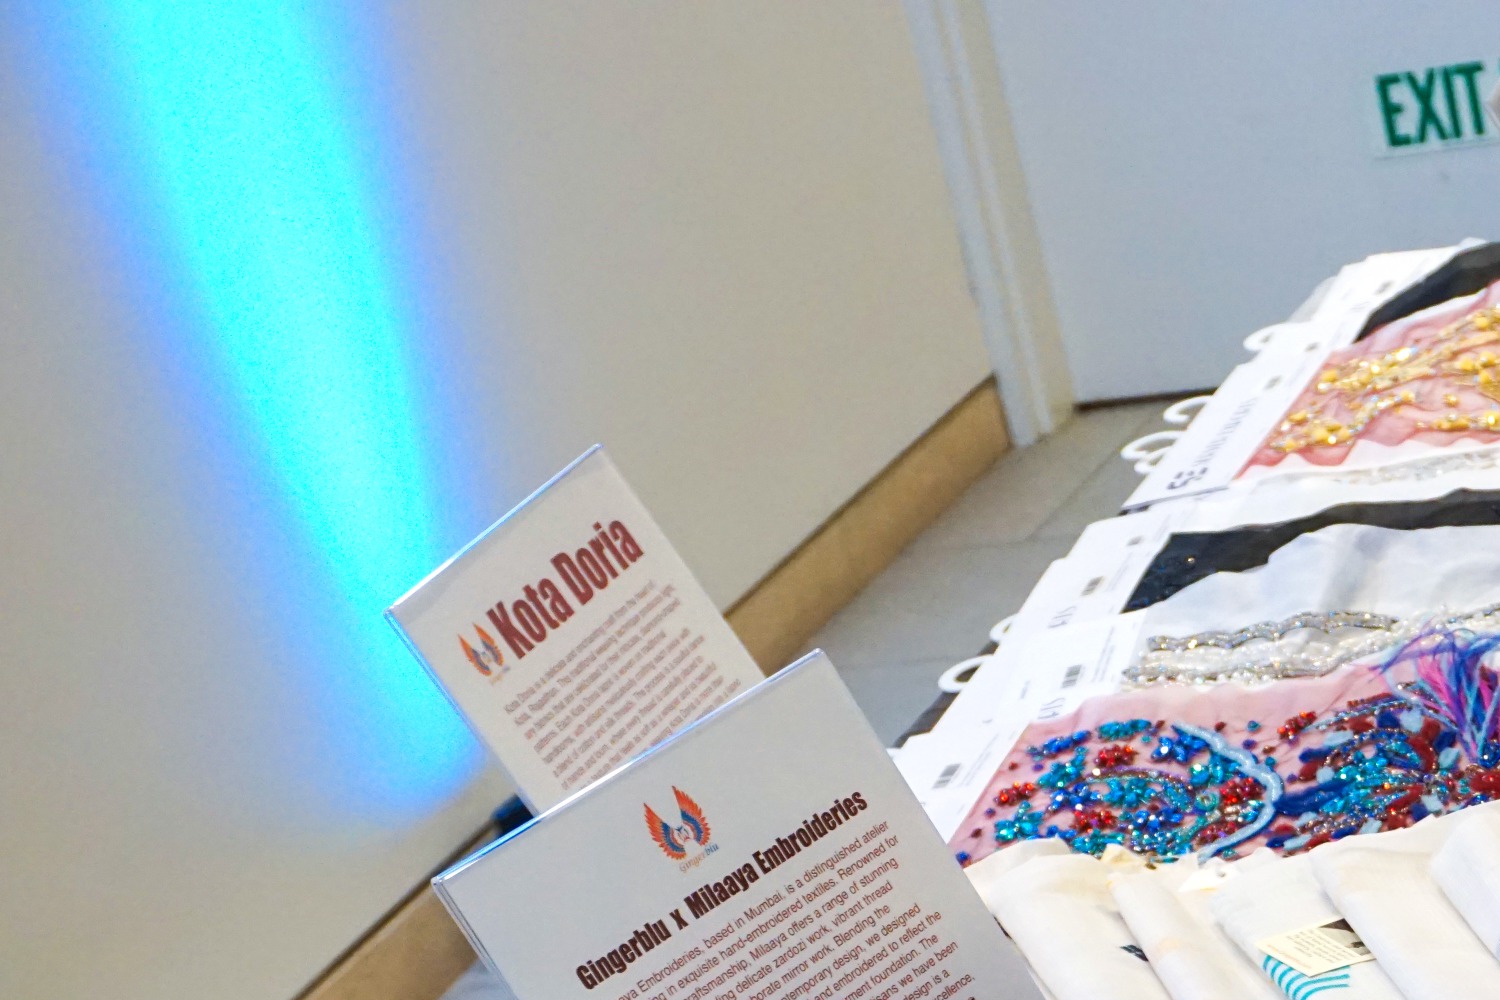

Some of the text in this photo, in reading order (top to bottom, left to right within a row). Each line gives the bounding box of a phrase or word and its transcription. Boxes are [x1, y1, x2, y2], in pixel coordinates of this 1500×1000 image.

[1375, 61, 1485, 147] EXIT
[486, 520, 645, 660] Kota Doria
[576, 791, 867, 989] Gingerblu x Milaaya Embroideries
[636, 946, 704, 992] Embroideries,
[702, 922, 734, 948] based
[743, 890, 785, 920] Mumbai,
[803, 837, 862, 882] distinguished
[862, 821, 888, 843] atelier
[677, 956, 719, 988] exquisite
[718, 898, 803, 959] hand-embroidered
[801, 878, 838, 903] textiles.
[837, 842, 885, 879] Renowned
[884, 835, 898, 847] for
[735, 964, 772, 992] delicate
[772, 941, 806, 968] zardozi
[831, 901, 863, 926] vibrant
[862, 880, 892, 905] thread
[749, 932, 788, 960] Milaaya
[787, 914, 813, 935] offers
[821, 891, 848, 912] range
[859, 858, 898, 887] stunning
[865, 933, 880, 946] we
[881, 902, 920, 936] designed
[781, 960, 808, 983] mirror
[809, 945, 834, 963] work.
[833, 915, 875, 946] Blending
[873, 905, 890, 918] the
[833, 946, 888, 991] embroidered
[899, 920, 926, 944] reflect
[925, 911, 941, 925] the
[870, 949, 920, 985] foundation.
[918, 934, 938, 949] The
[897, 974, 913, 987] we
[912, 958, 935, 976] have
[934, 941, 958, 961] been
